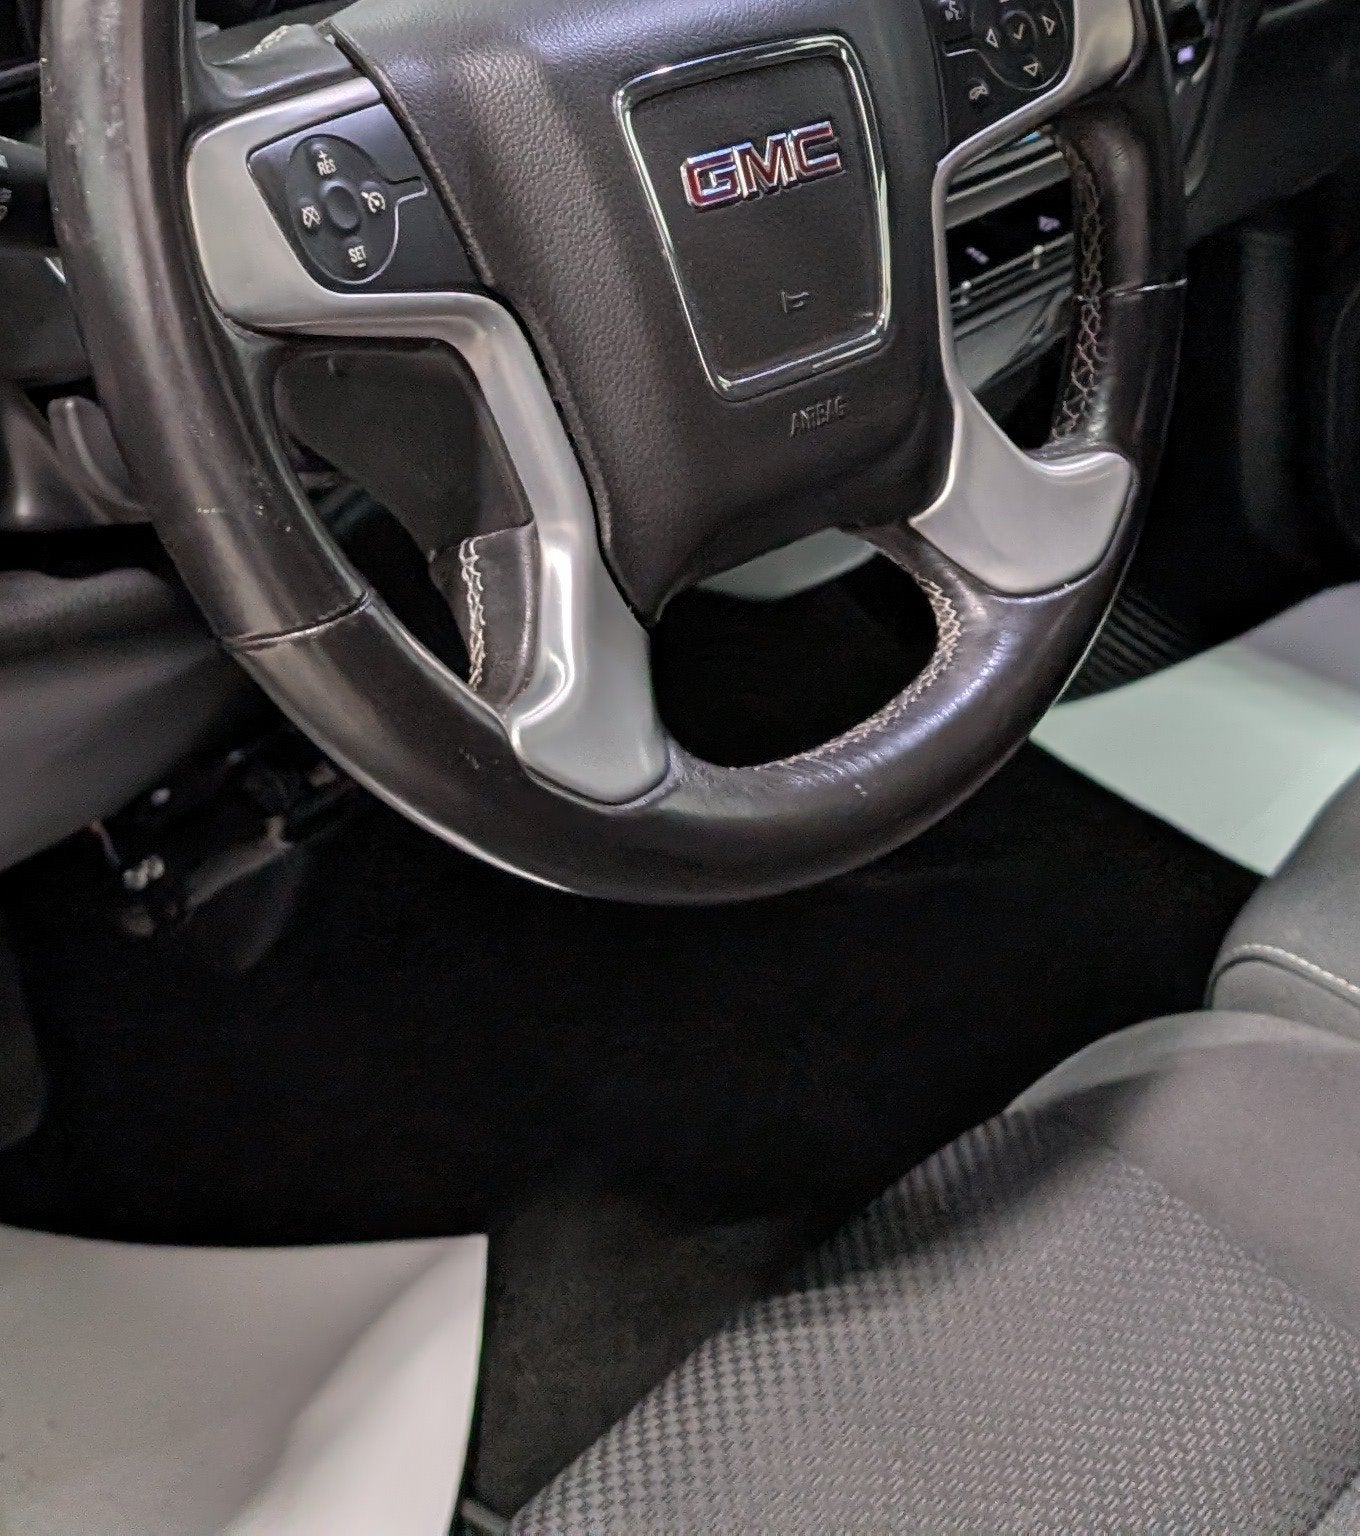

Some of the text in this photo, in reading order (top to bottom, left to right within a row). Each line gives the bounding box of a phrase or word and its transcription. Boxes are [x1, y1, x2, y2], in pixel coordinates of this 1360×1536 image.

[316, 157, 337, 177] RES
[680, 120, 843, 208] GMC
[347, 244, 367, 263] SET
